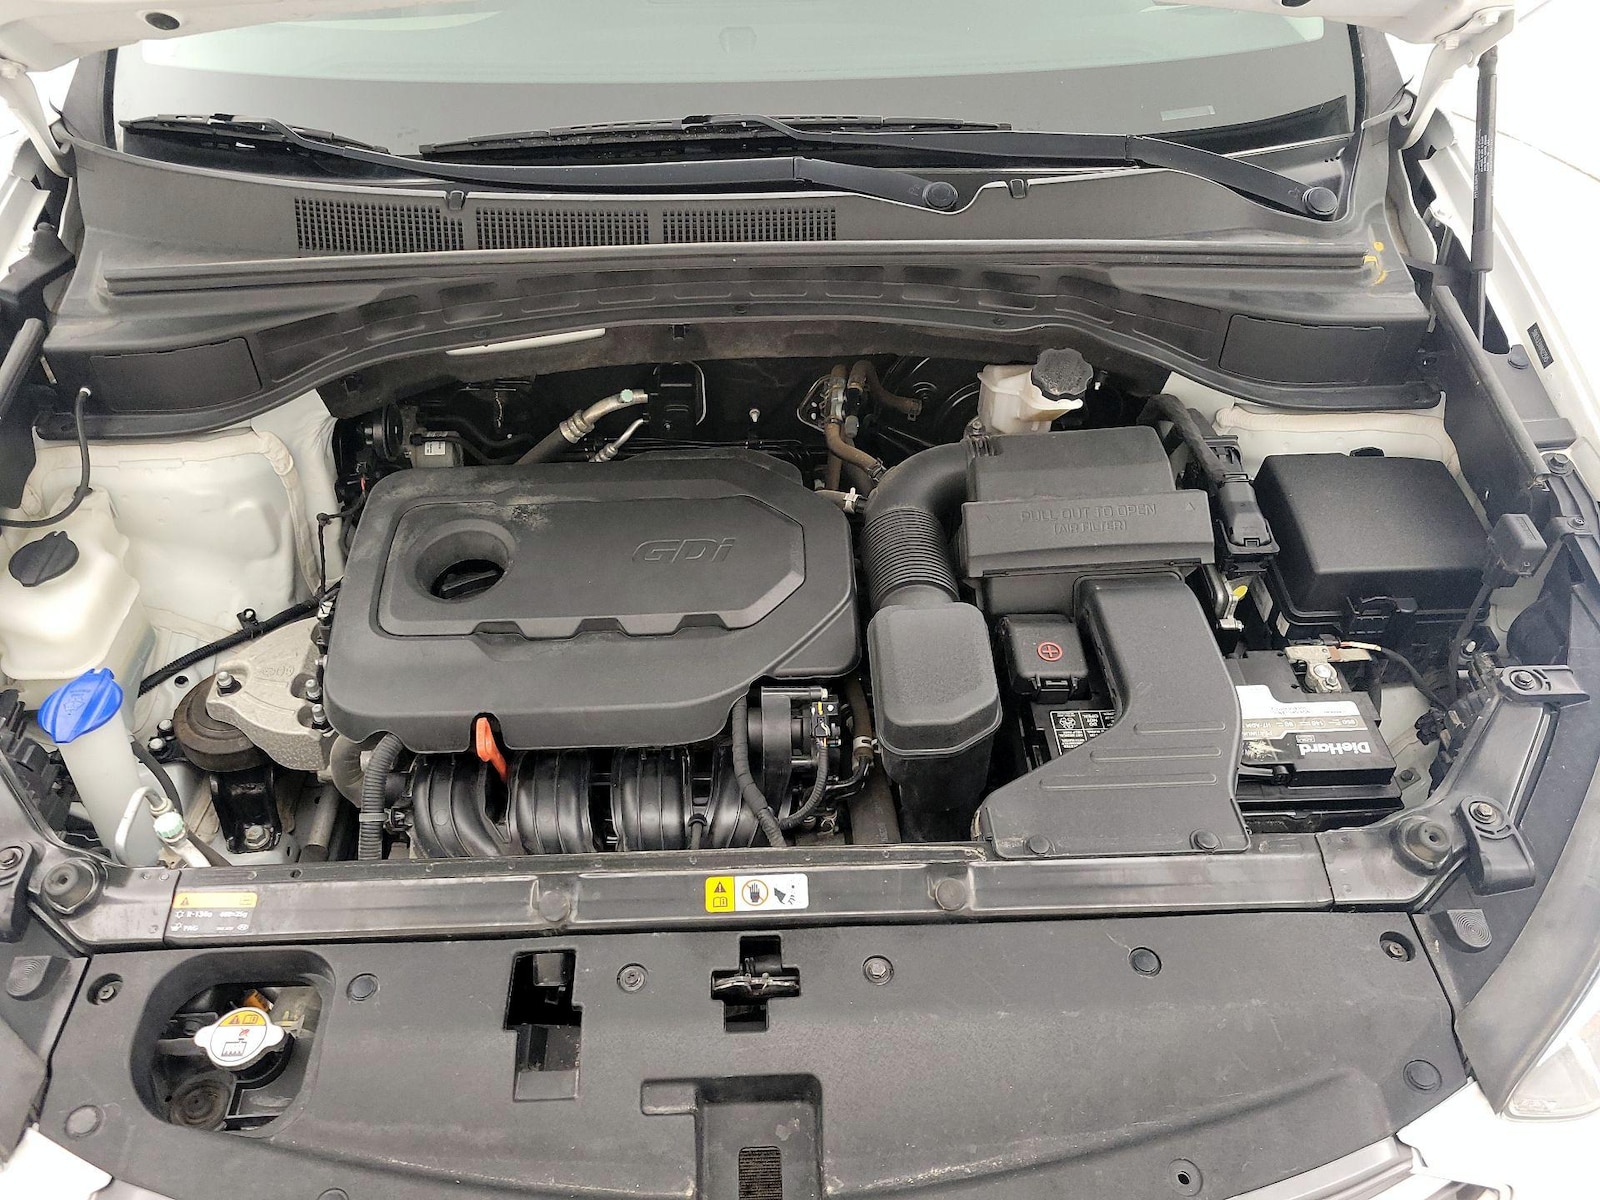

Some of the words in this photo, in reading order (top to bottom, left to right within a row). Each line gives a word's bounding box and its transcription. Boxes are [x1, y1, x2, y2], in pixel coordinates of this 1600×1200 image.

[1020, 509, 1058, 522] PULL
[1061, 506, 1090, 520] OUT
[1095, 505, 1114, 519] TO
[1117, 503, 1157, 517] OPEN
[1297, 741, 1372, 756] DieHard
